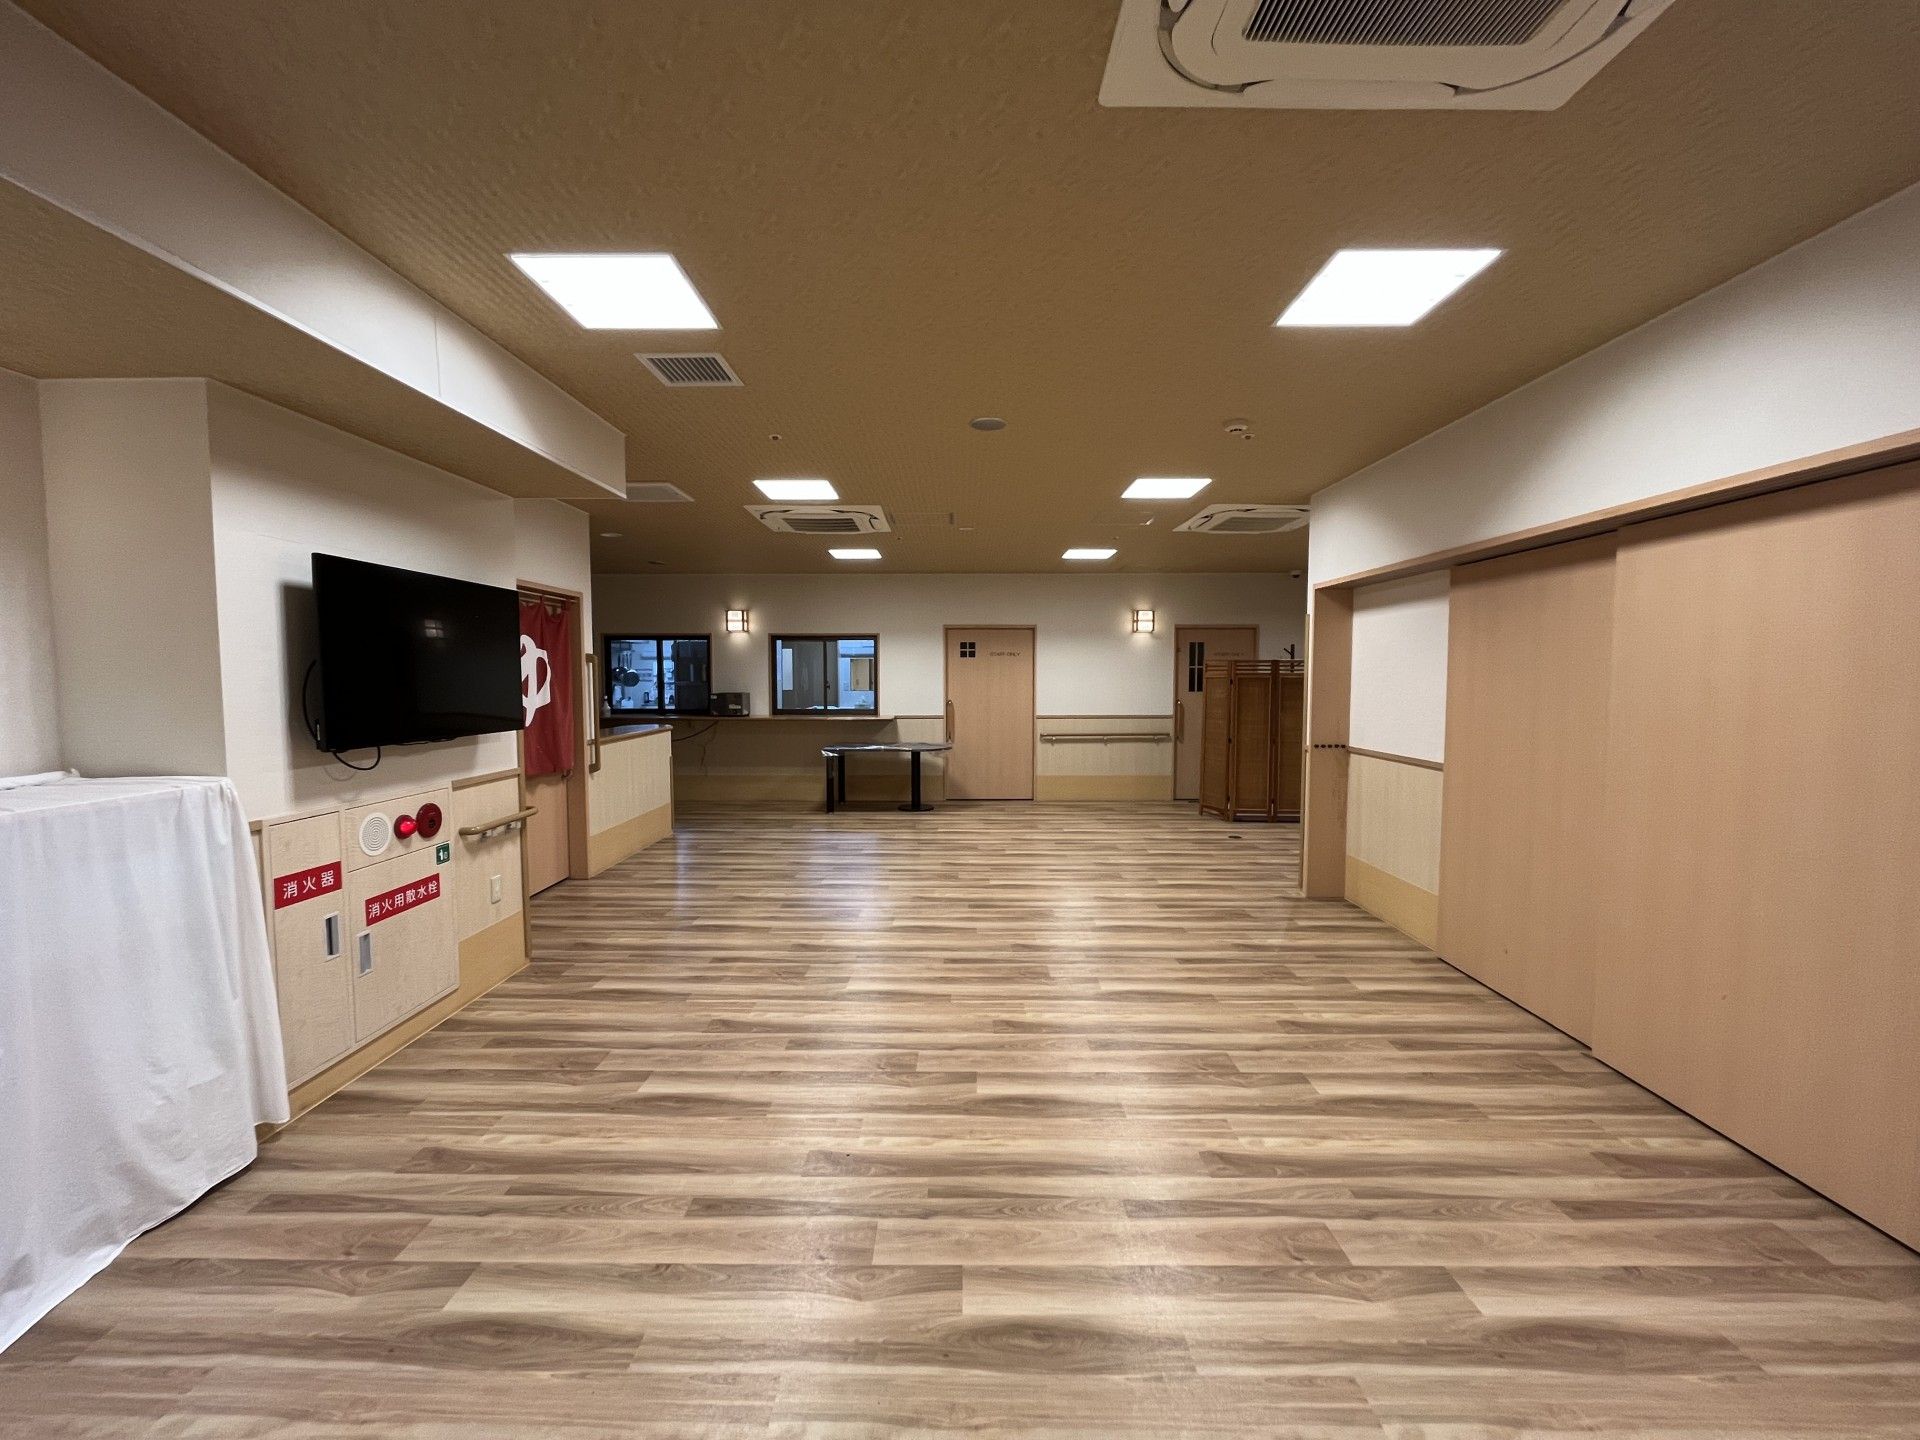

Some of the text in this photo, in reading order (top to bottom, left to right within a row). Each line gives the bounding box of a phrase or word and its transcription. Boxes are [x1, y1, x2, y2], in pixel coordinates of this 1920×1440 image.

[283, 869, 335, 900] 消火器
[368, 879, 439, 919] 消火用散水栓
